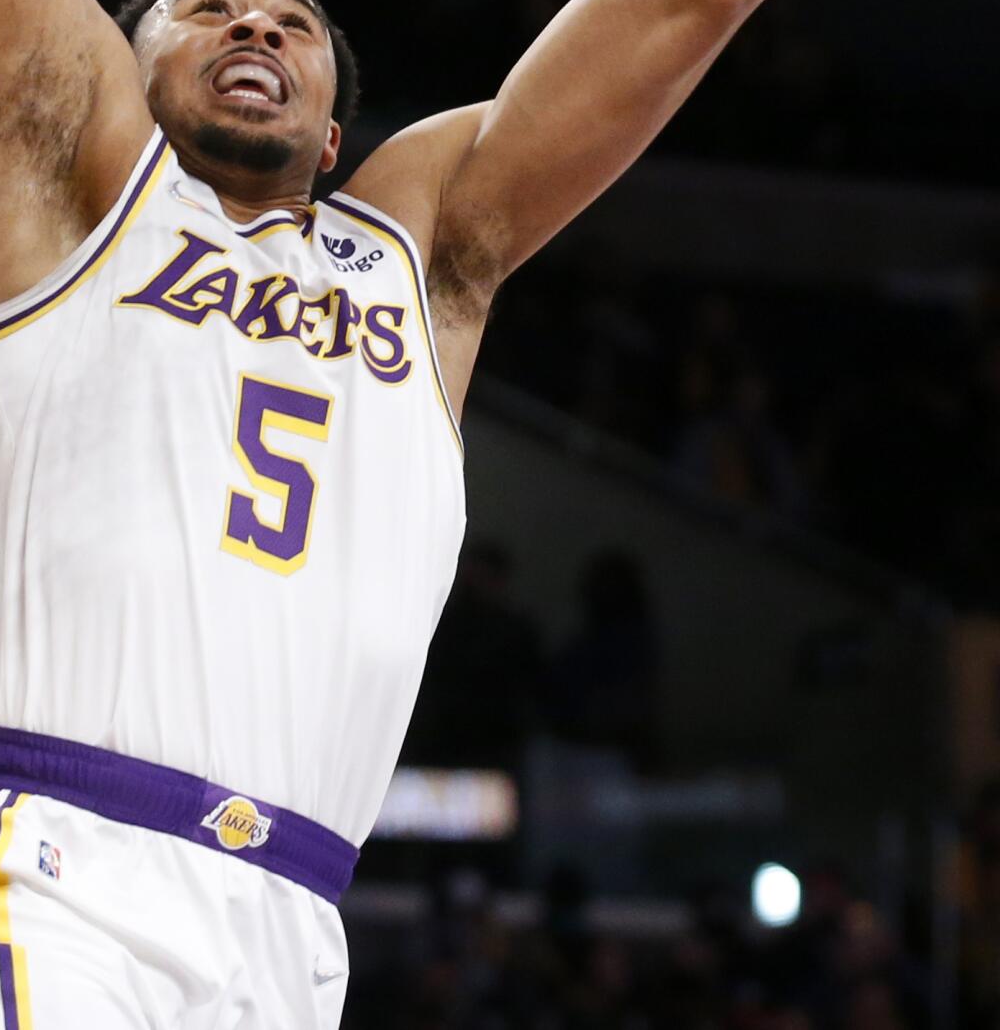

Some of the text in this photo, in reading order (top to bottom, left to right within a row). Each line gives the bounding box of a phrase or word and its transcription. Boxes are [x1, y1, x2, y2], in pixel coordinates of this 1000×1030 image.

[114, 228, 413, 387] LAKERS
[219, 371, 334, 577] 5
[206, 803, 271, 845] LAKERS
